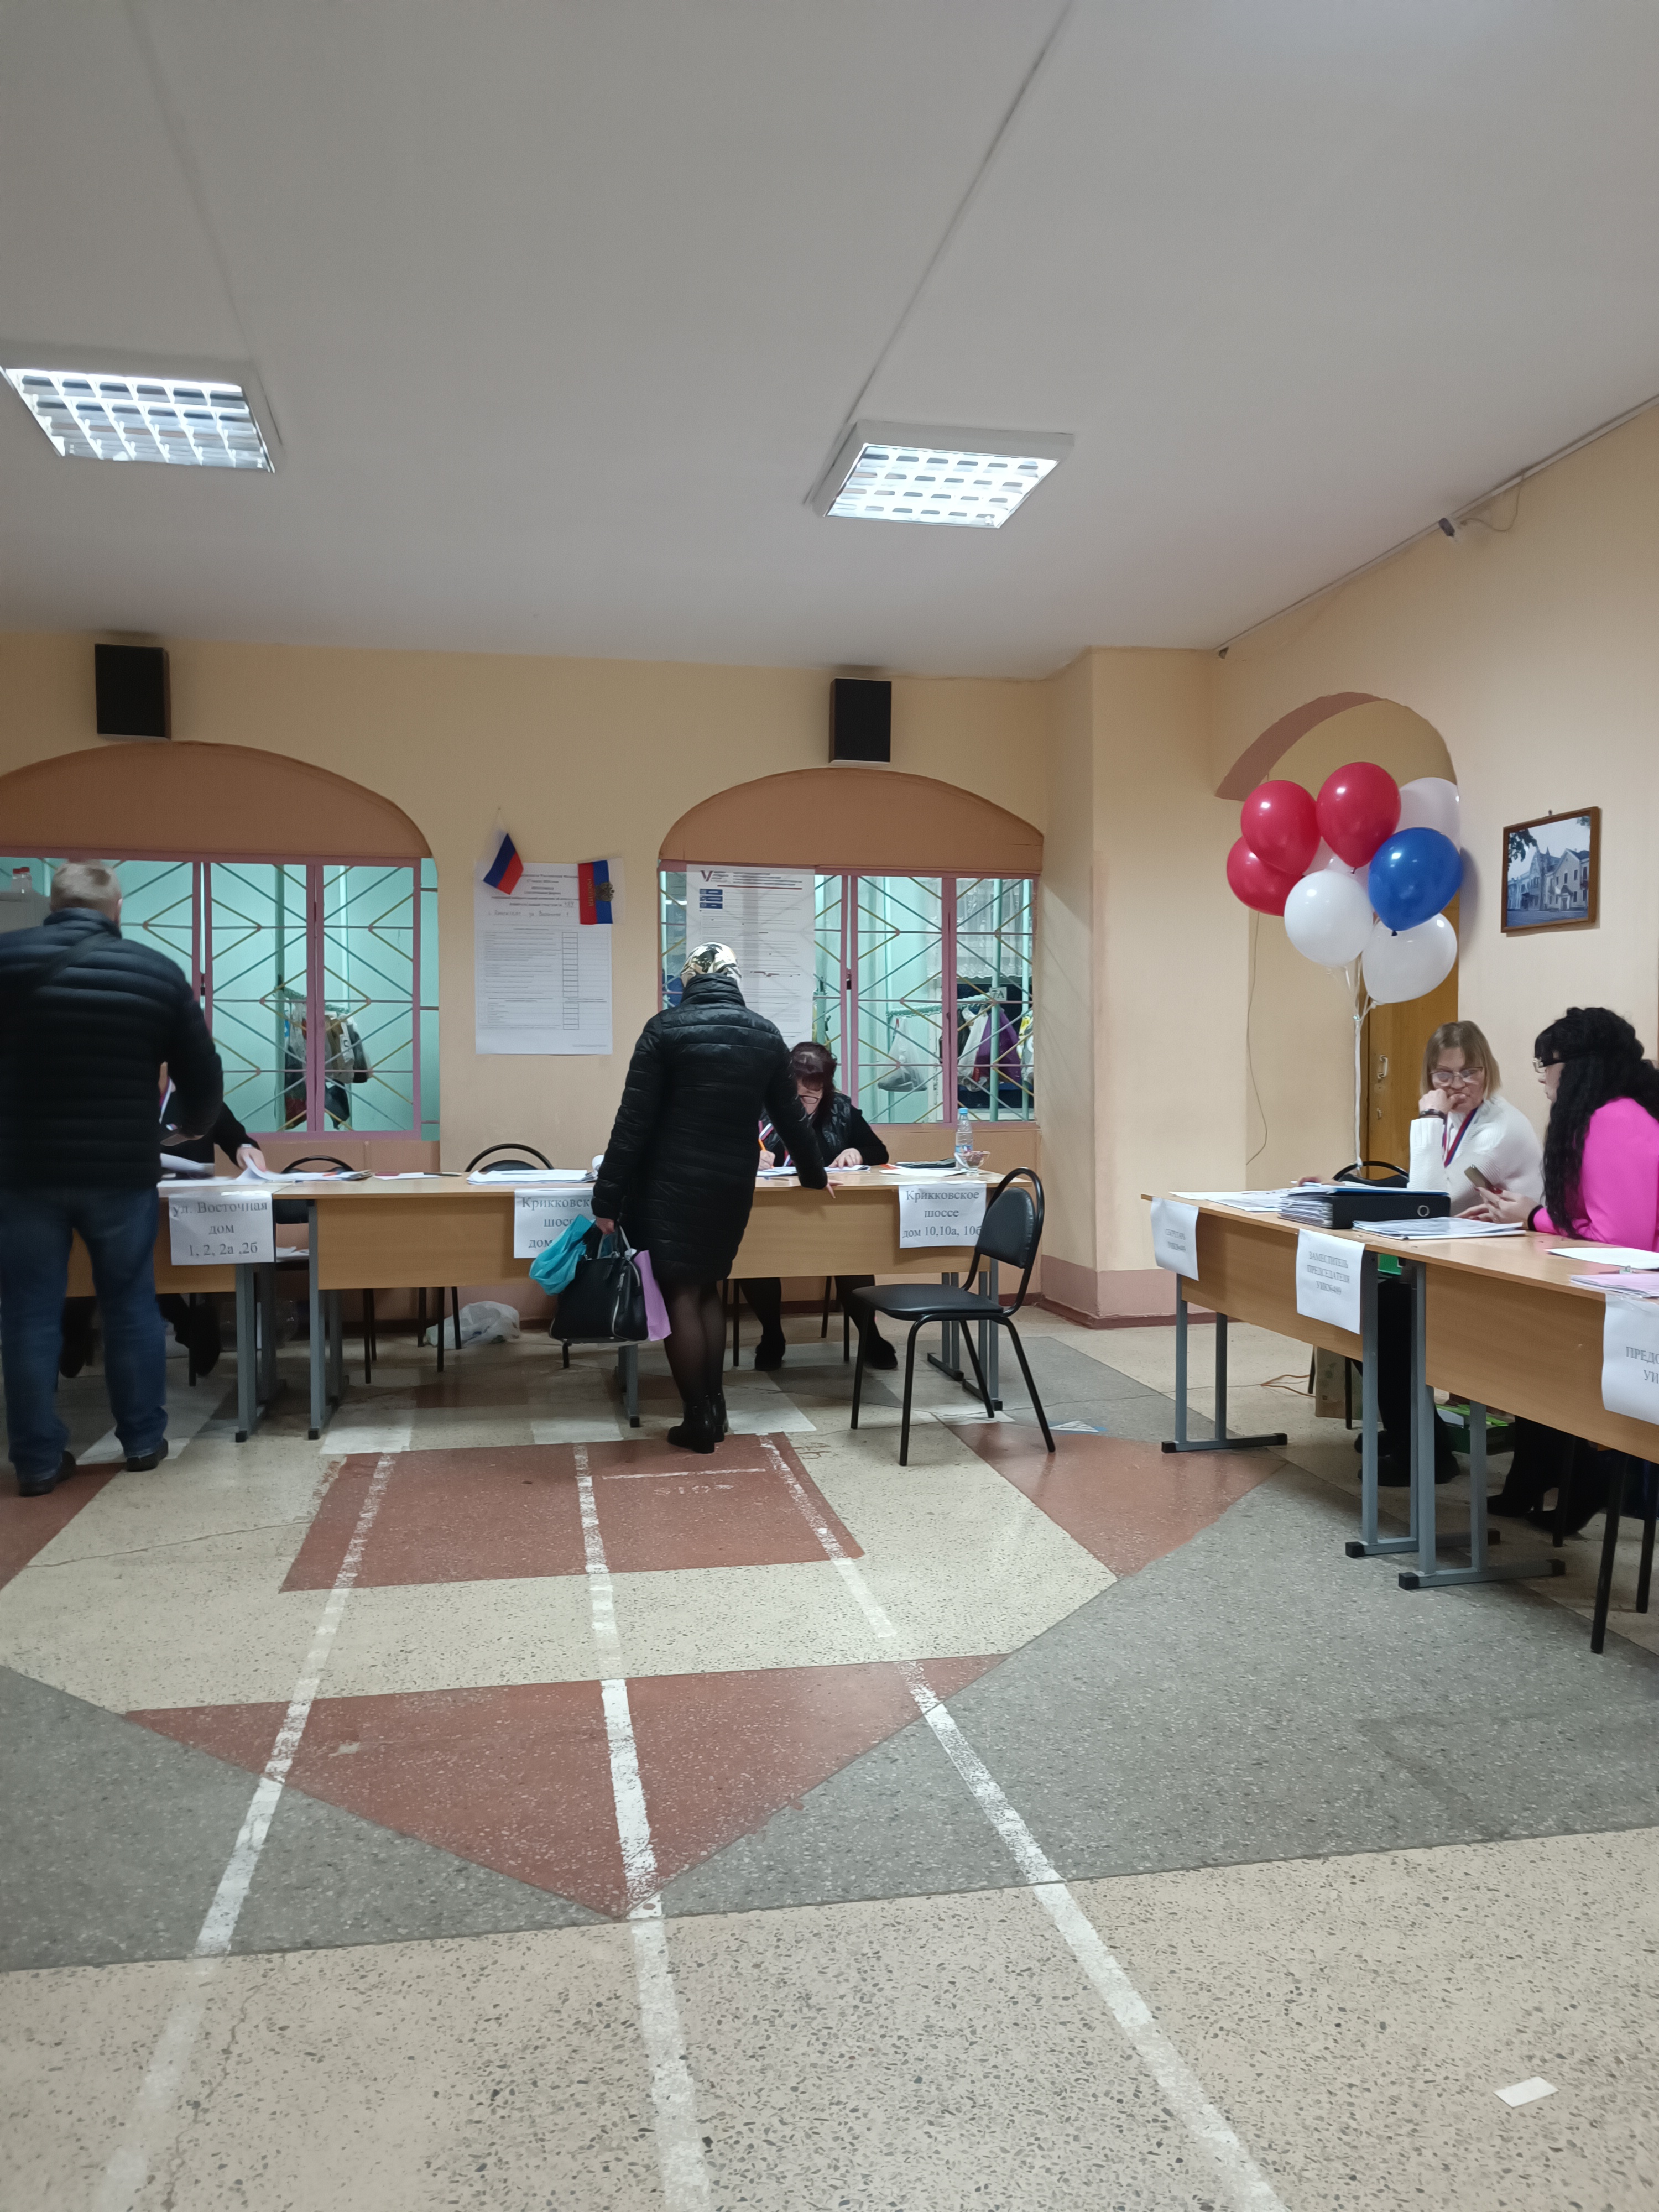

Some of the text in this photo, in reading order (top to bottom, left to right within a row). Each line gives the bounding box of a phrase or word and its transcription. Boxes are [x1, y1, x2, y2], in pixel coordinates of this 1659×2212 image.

[906, 1190, 980, 1203] Крикковское
[173, 1201, 268, 1217] ул. Восточная
[208, 1224, 235, 1235] дом
[902, 1229, 921, 1238] дом
[1309, 1251, 1348, 1269] ЗАМЕСТИТЕЛЬ
